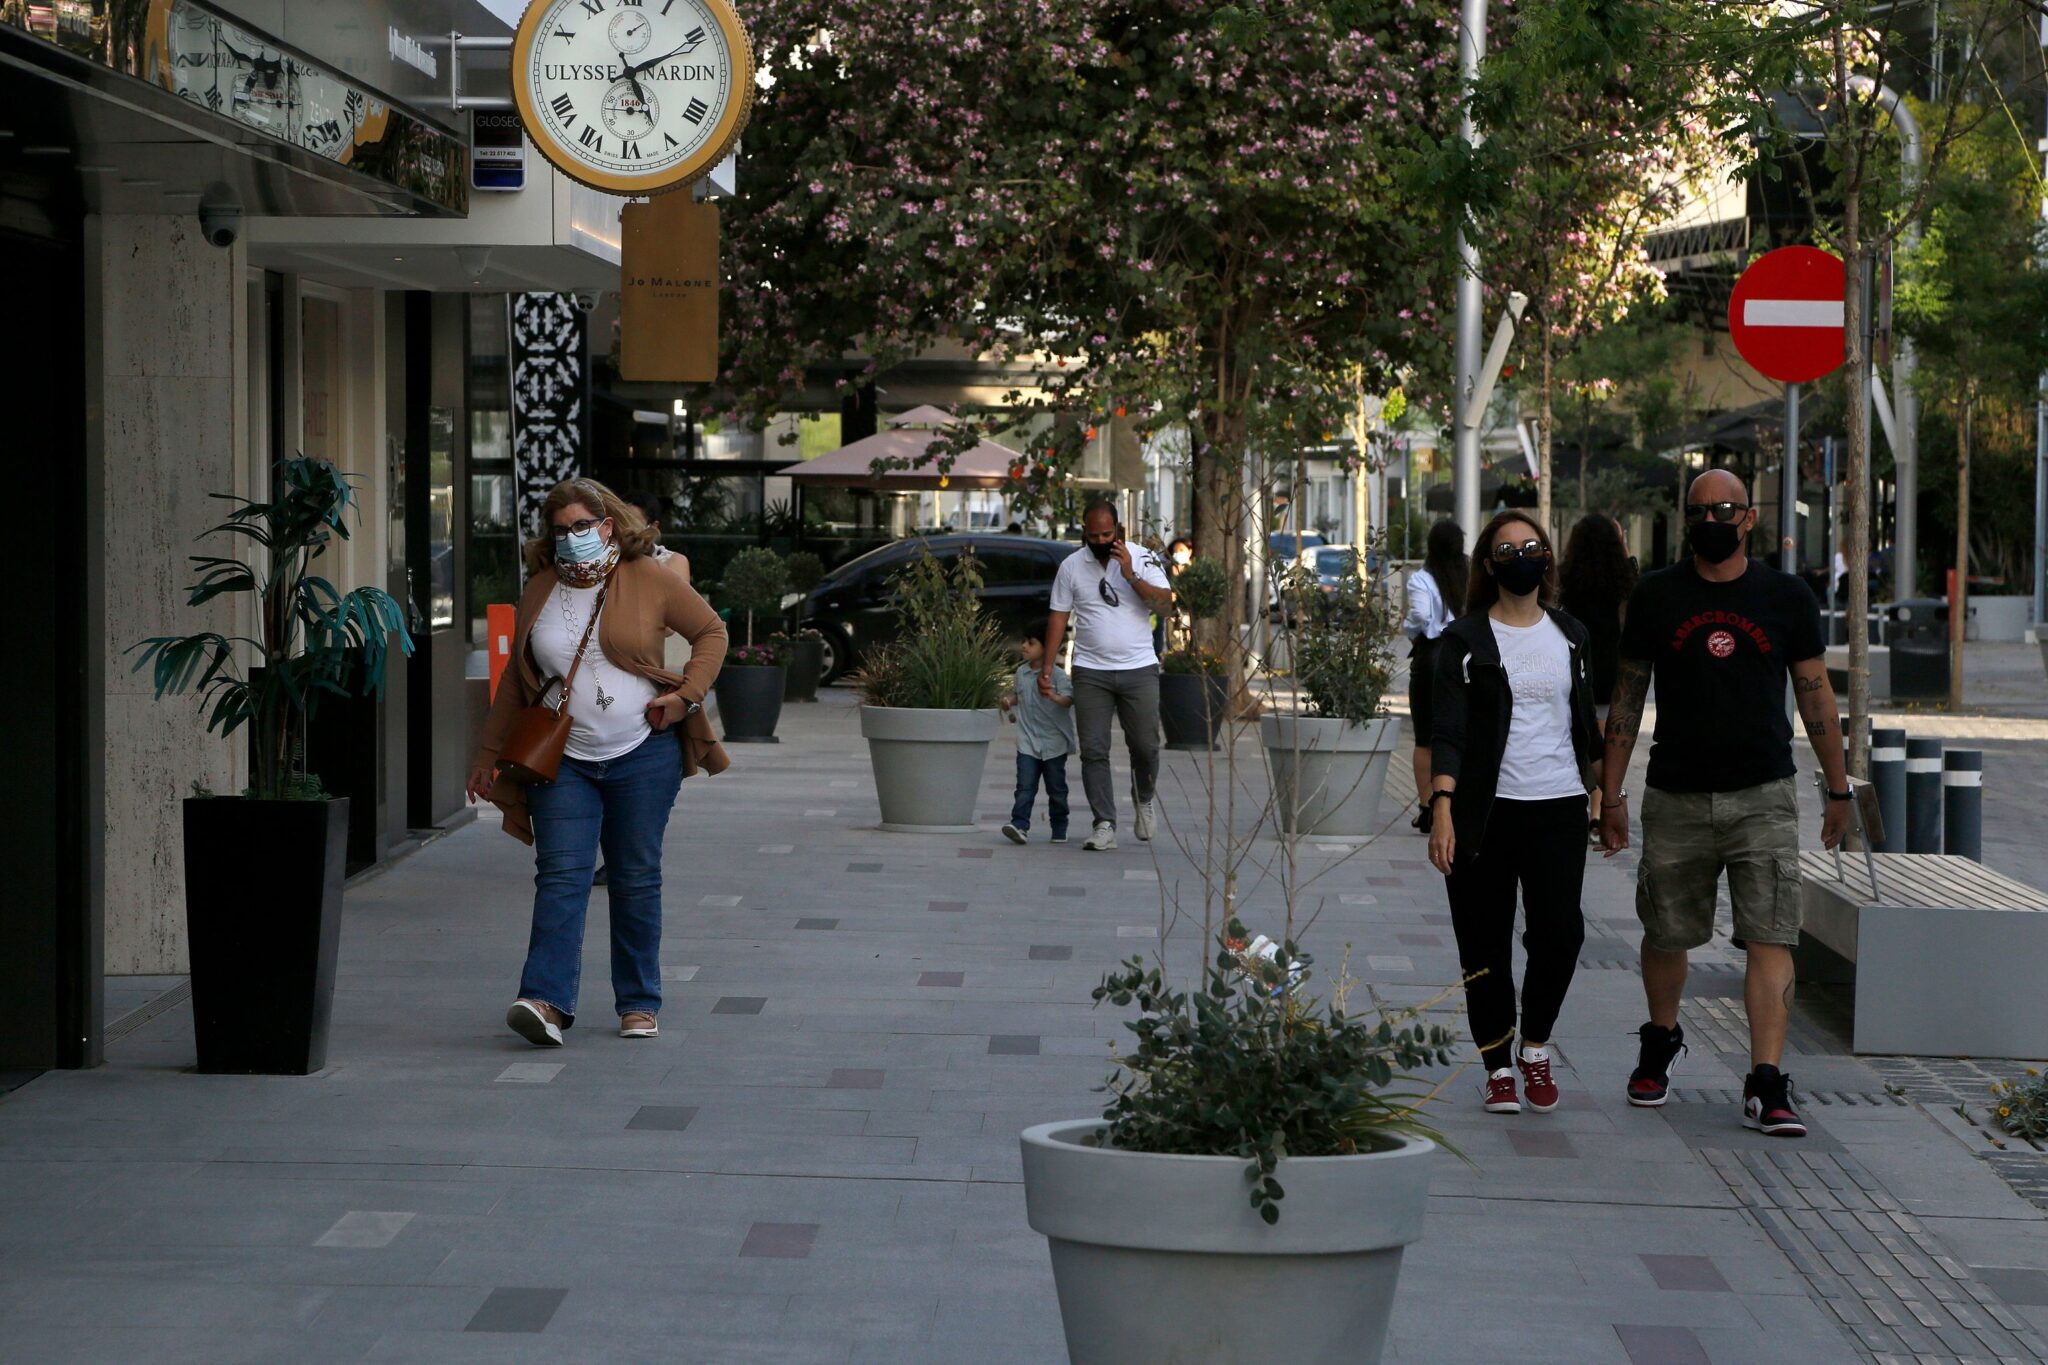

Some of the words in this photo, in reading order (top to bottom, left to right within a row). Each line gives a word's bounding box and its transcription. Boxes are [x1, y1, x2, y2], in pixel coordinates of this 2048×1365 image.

[545, 64, 618, 81] ULYSSE
[643, 65, 715, 81] NARDIN
[621, 99, 641, 107] 1846
[1672, 610, 1773, 655] ABERCROMBIE
